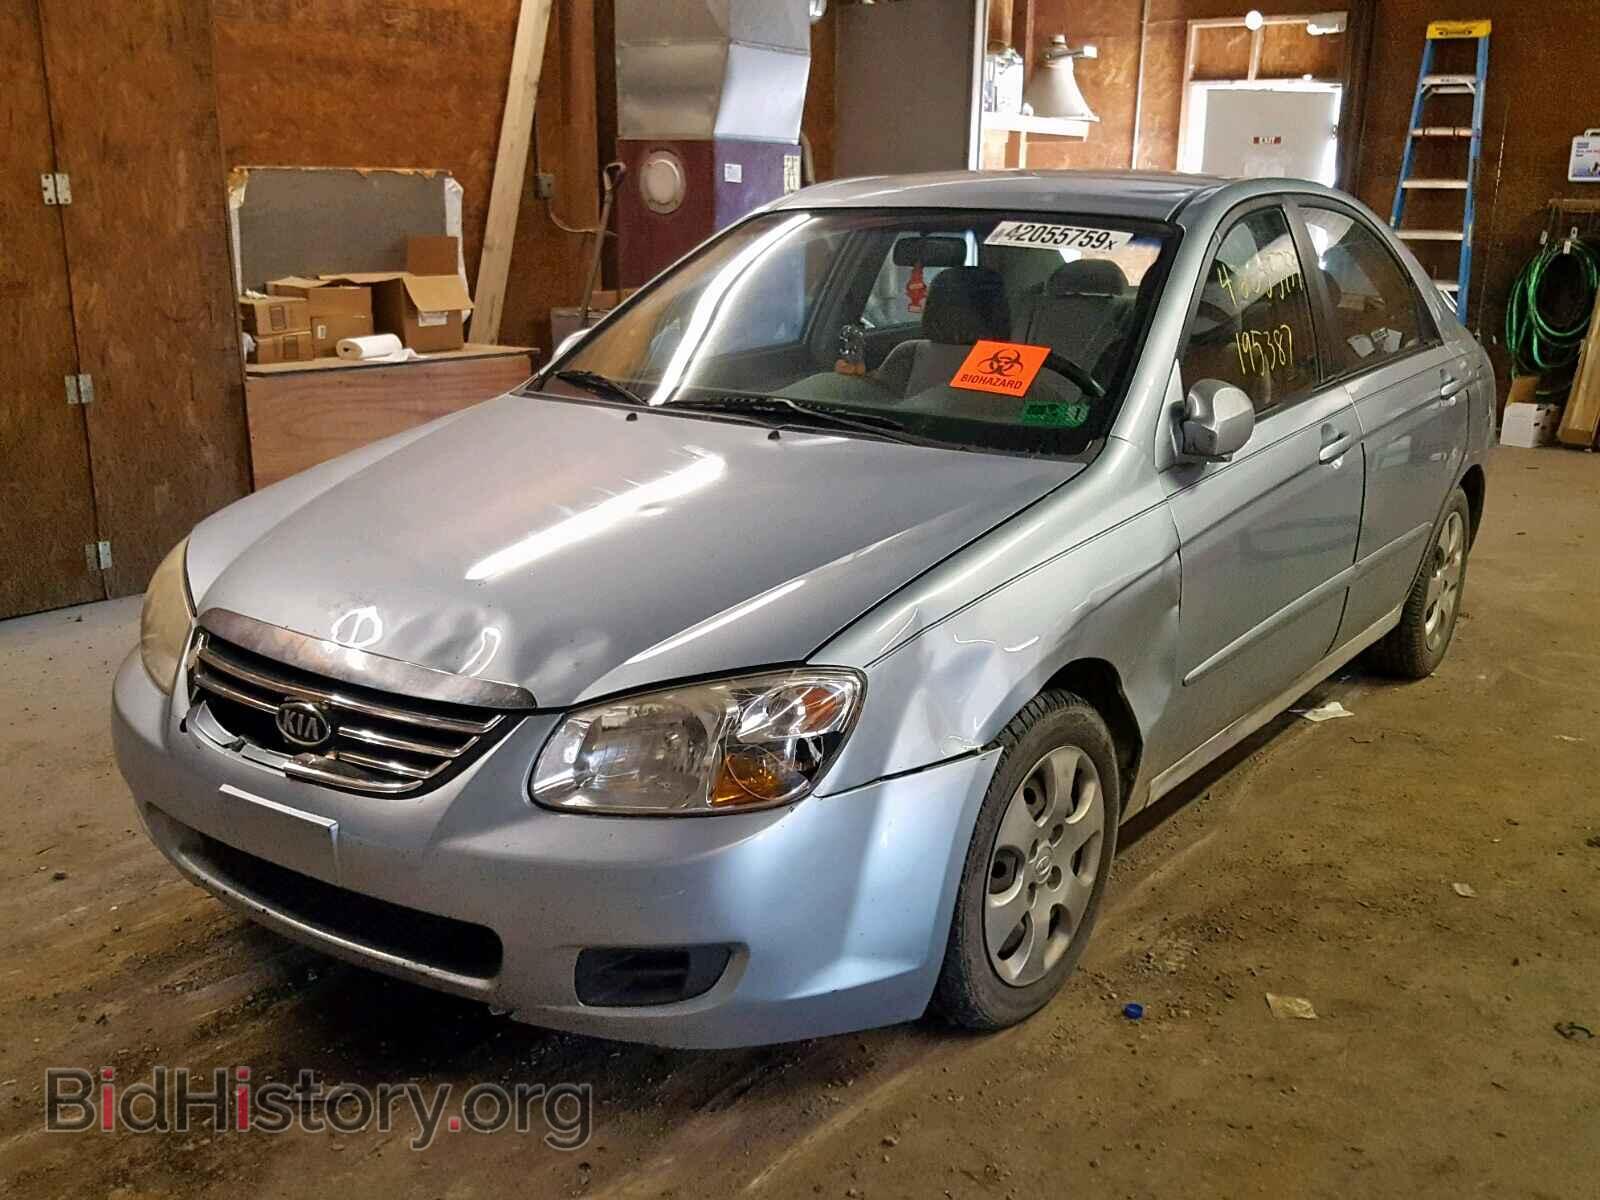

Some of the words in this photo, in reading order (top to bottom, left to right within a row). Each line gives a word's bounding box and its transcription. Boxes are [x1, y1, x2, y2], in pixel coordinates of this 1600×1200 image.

[1235, 325, 1293, 376] 195387
[960, 374, 1023, 390] BIOHAZARD
[283, 709, 319, 740] KIA
